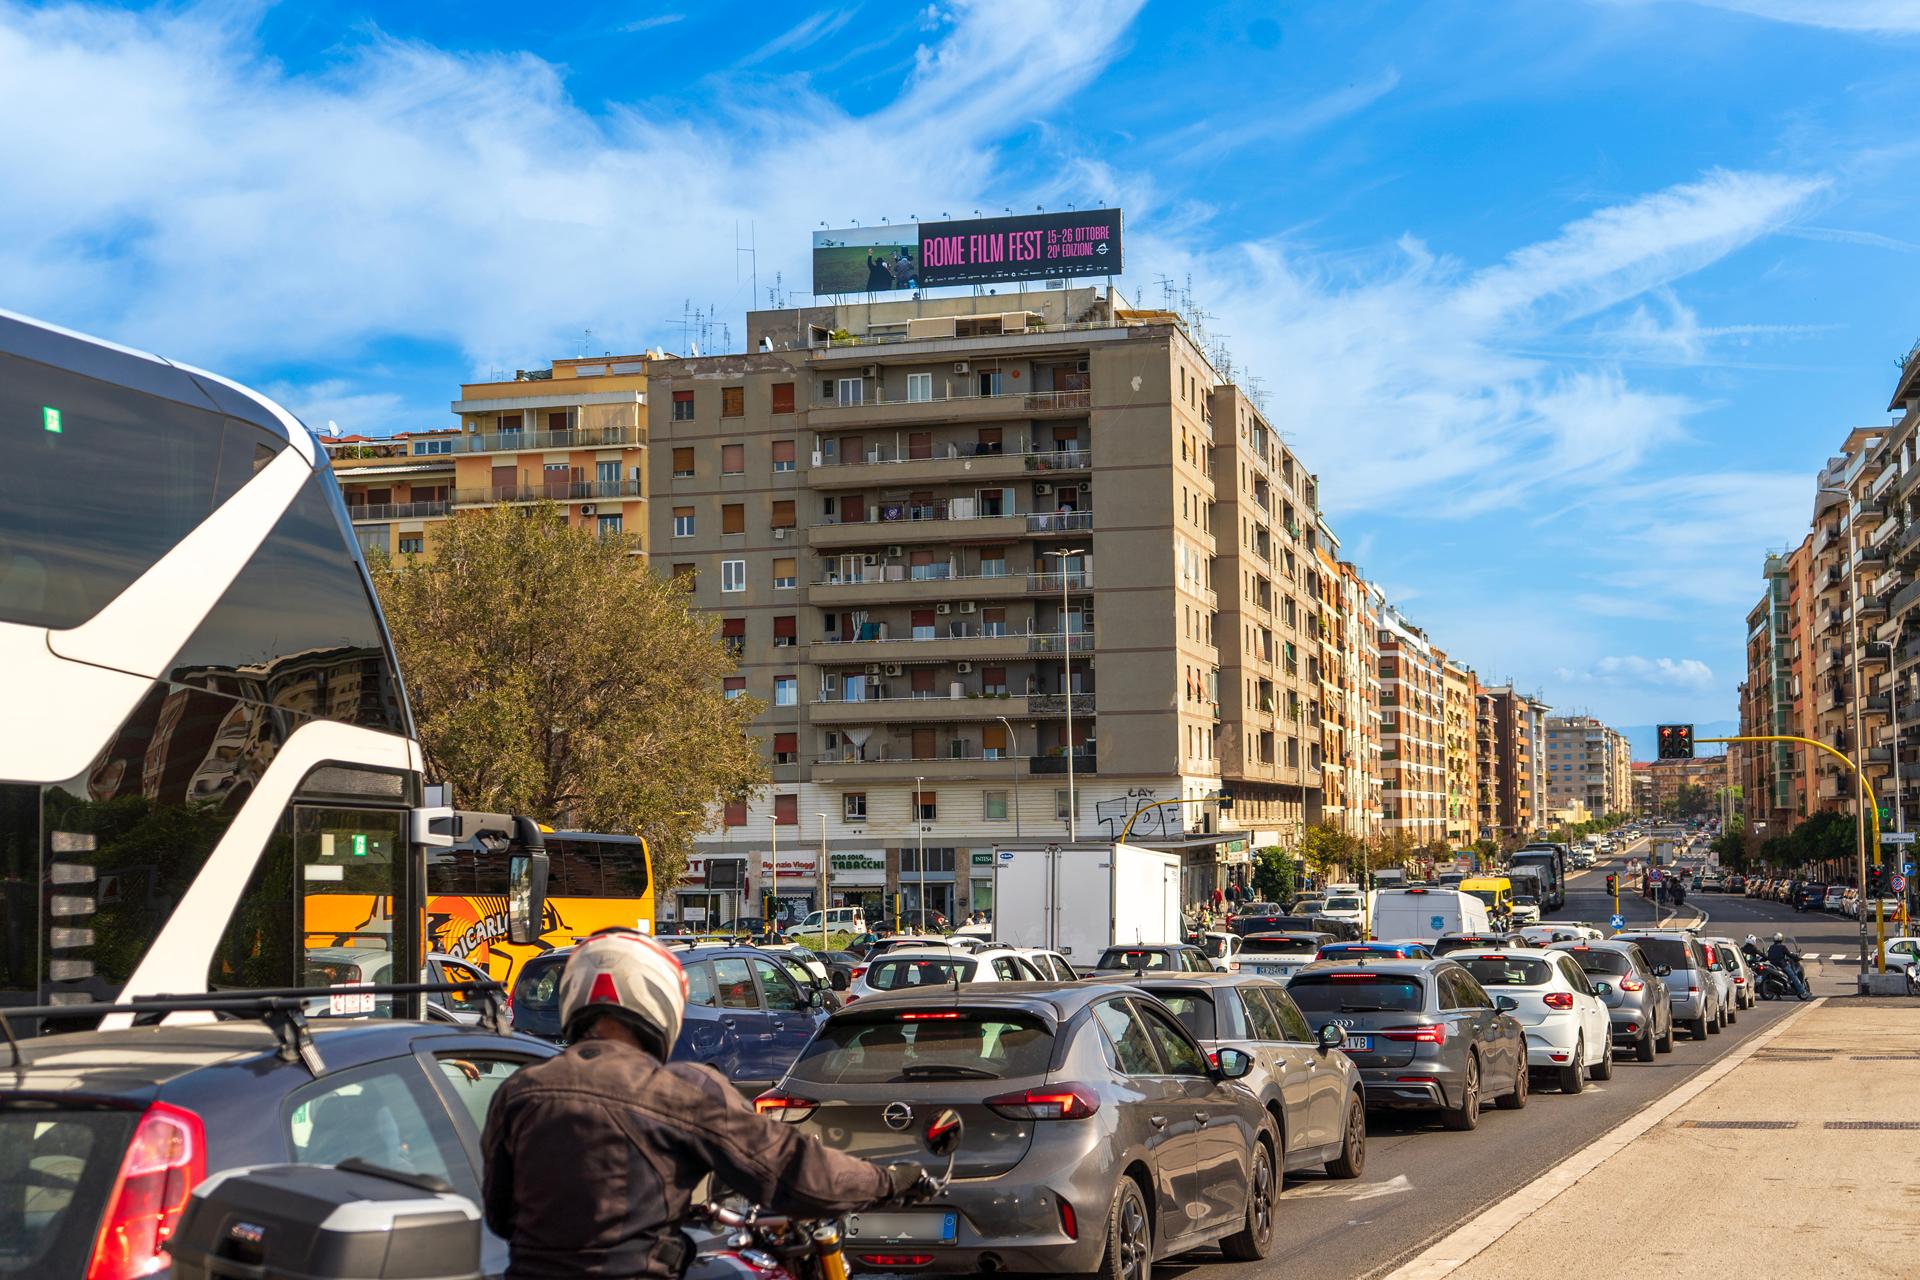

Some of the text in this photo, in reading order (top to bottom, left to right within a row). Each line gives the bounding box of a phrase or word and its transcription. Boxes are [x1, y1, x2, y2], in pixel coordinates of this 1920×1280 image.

[1075, 225, 1110, 241] OTTOBRE
[923, 231, 1043, 267] ROME FILM FEST
[1062, 242, 1094, 257] EDIZIONE
[793, 861, 815, 869] Viaggi
[832, 861, 884, 869] TABACCHI
